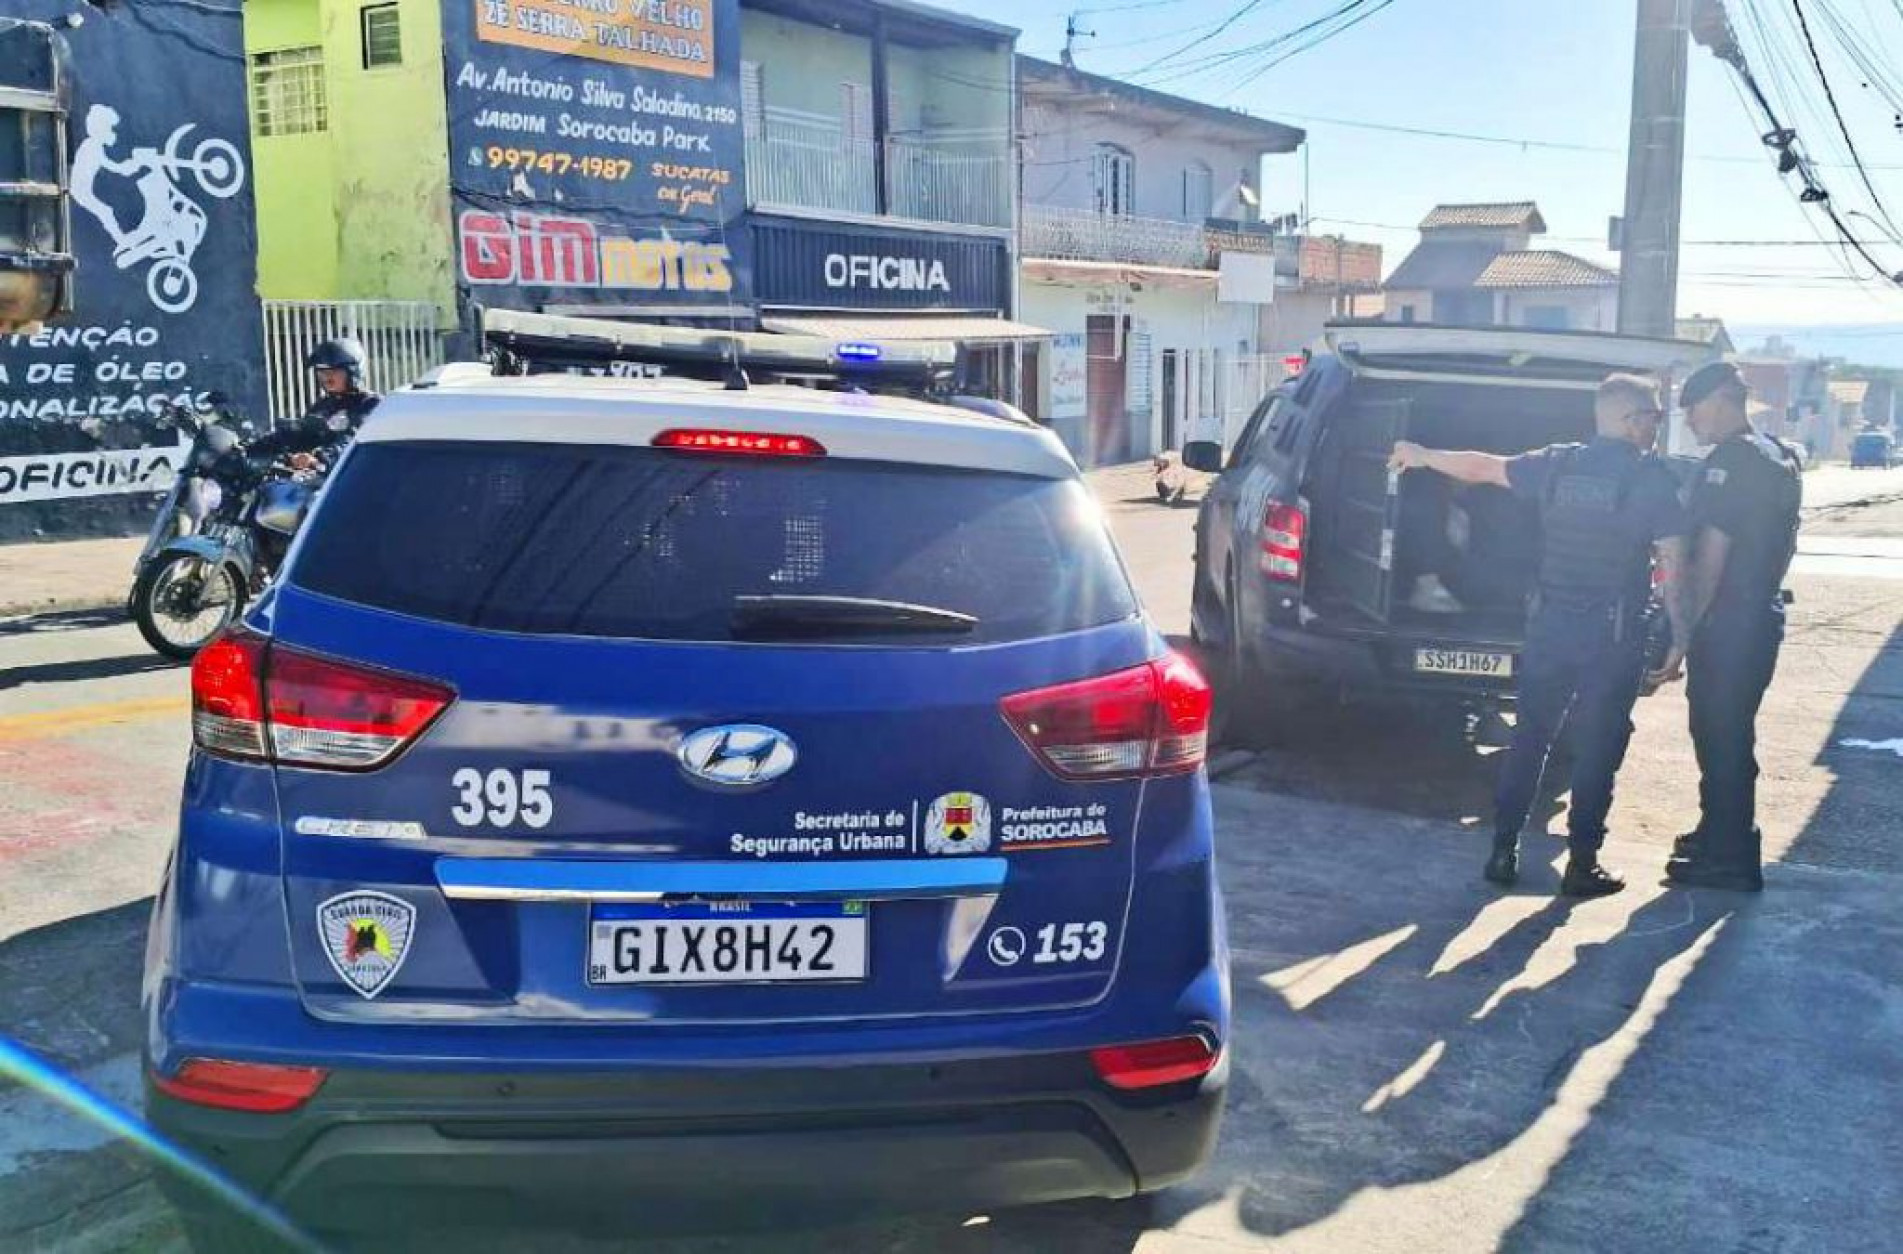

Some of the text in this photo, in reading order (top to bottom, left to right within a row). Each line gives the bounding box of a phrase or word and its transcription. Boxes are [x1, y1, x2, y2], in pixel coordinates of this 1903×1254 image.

[594, 23, 706, 62] TALHADA
[473, 109, 547, 134] JARDIM
[556, 113, 657, 147] Sorocaba
[486, 146, 632, 181] 99747-1987
[824, 253, 951, 292] OFICINA
[26, 363, 76, 384] DE
[451, 768, 553, 828] 395
[1002, 806, 1083, 821] Prefeitura
[794, 810, 905, 831] Secretaria de
[1001, 819, 1107, 842] SOROCABA
[731, 831, 905, 858] Segurança Urbana
[614, 925, 834, 974] GIX8H42
[1034, 921, 1107, 963] 153
